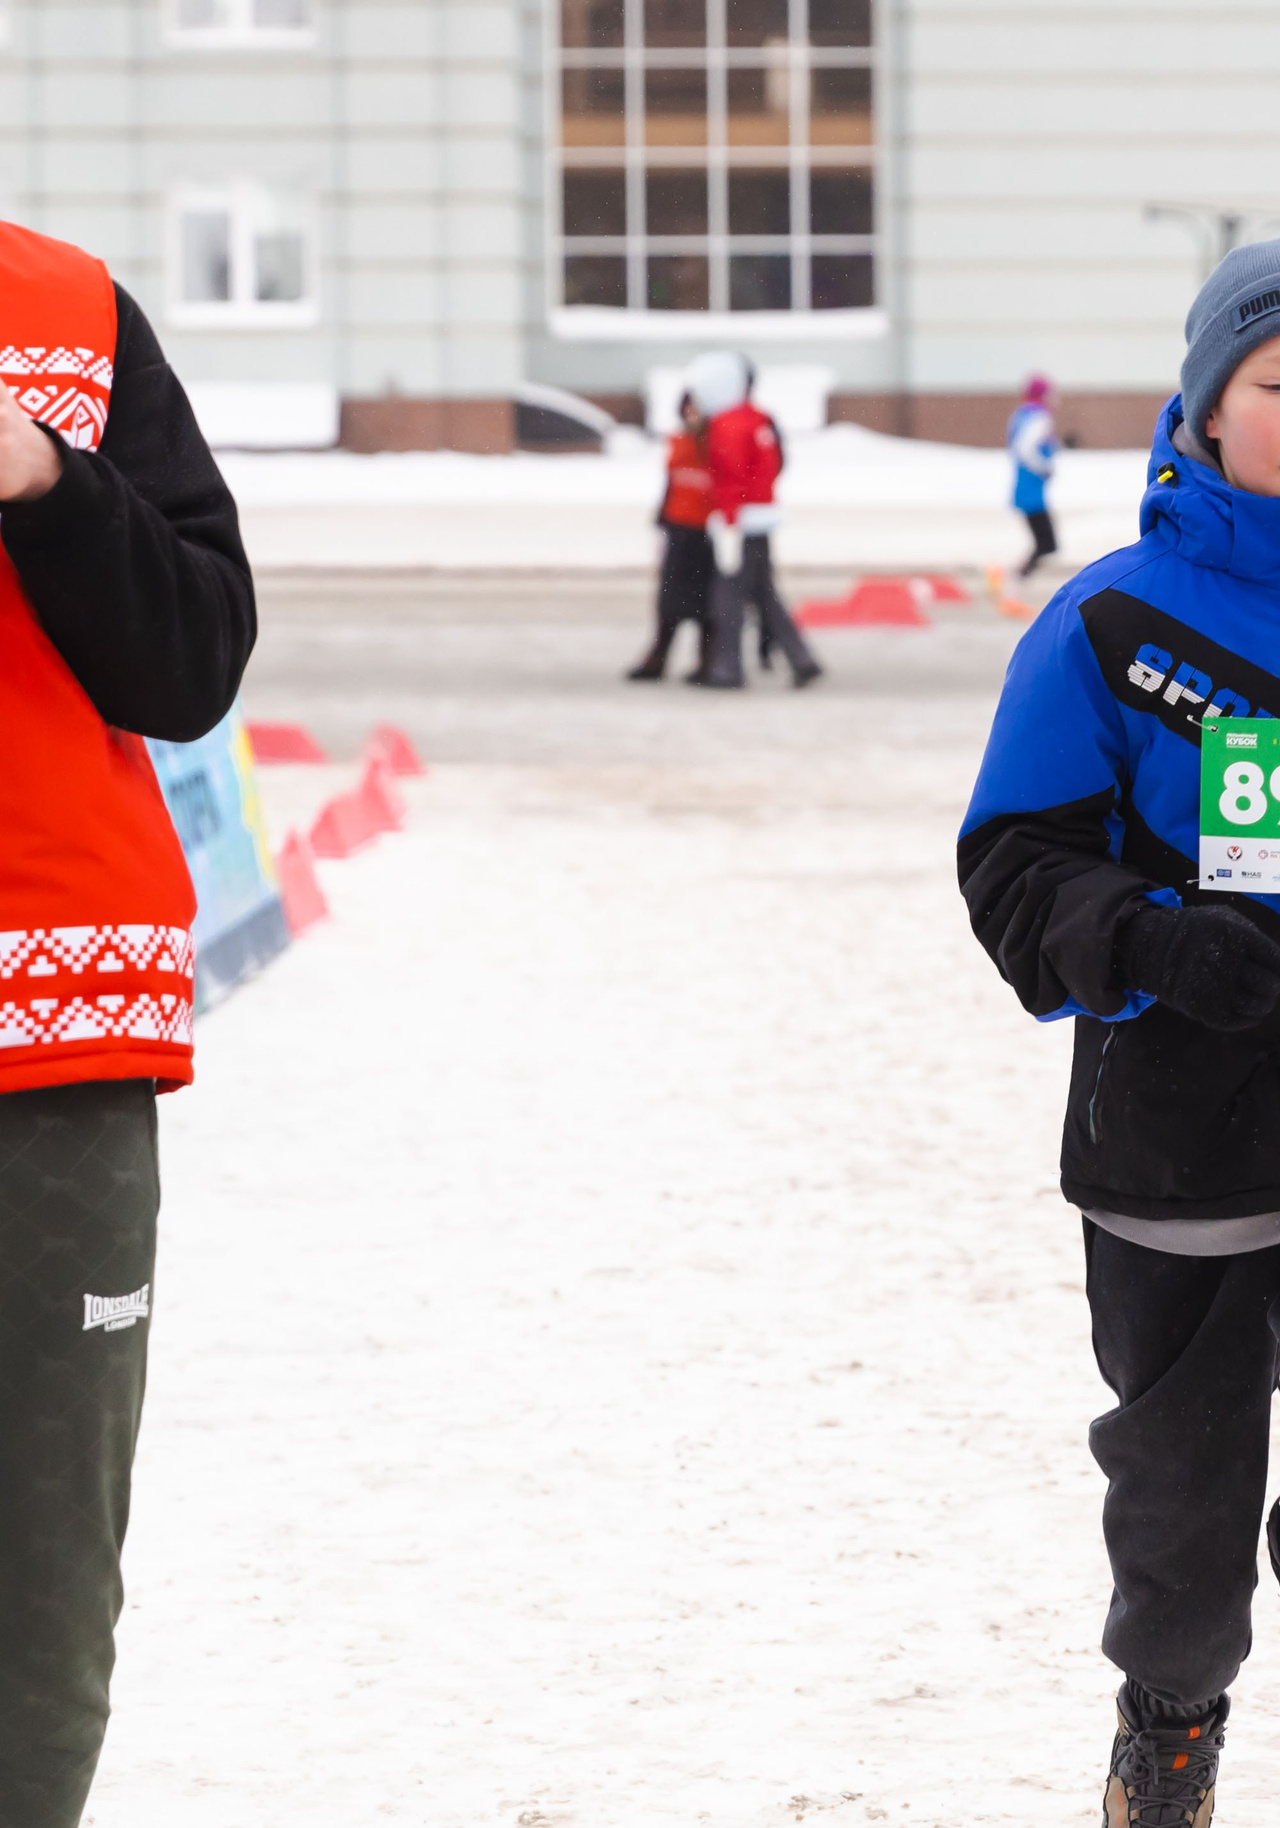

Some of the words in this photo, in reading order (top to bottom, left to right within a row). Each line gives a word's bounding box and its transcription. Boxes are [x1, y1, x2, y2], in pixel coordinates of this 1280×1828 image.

[1127, 643, 1279, 719] SPO
[1226, 738, 1258, 747] КУБОК
[82, 1283, 149, 1331] LONSDALE
